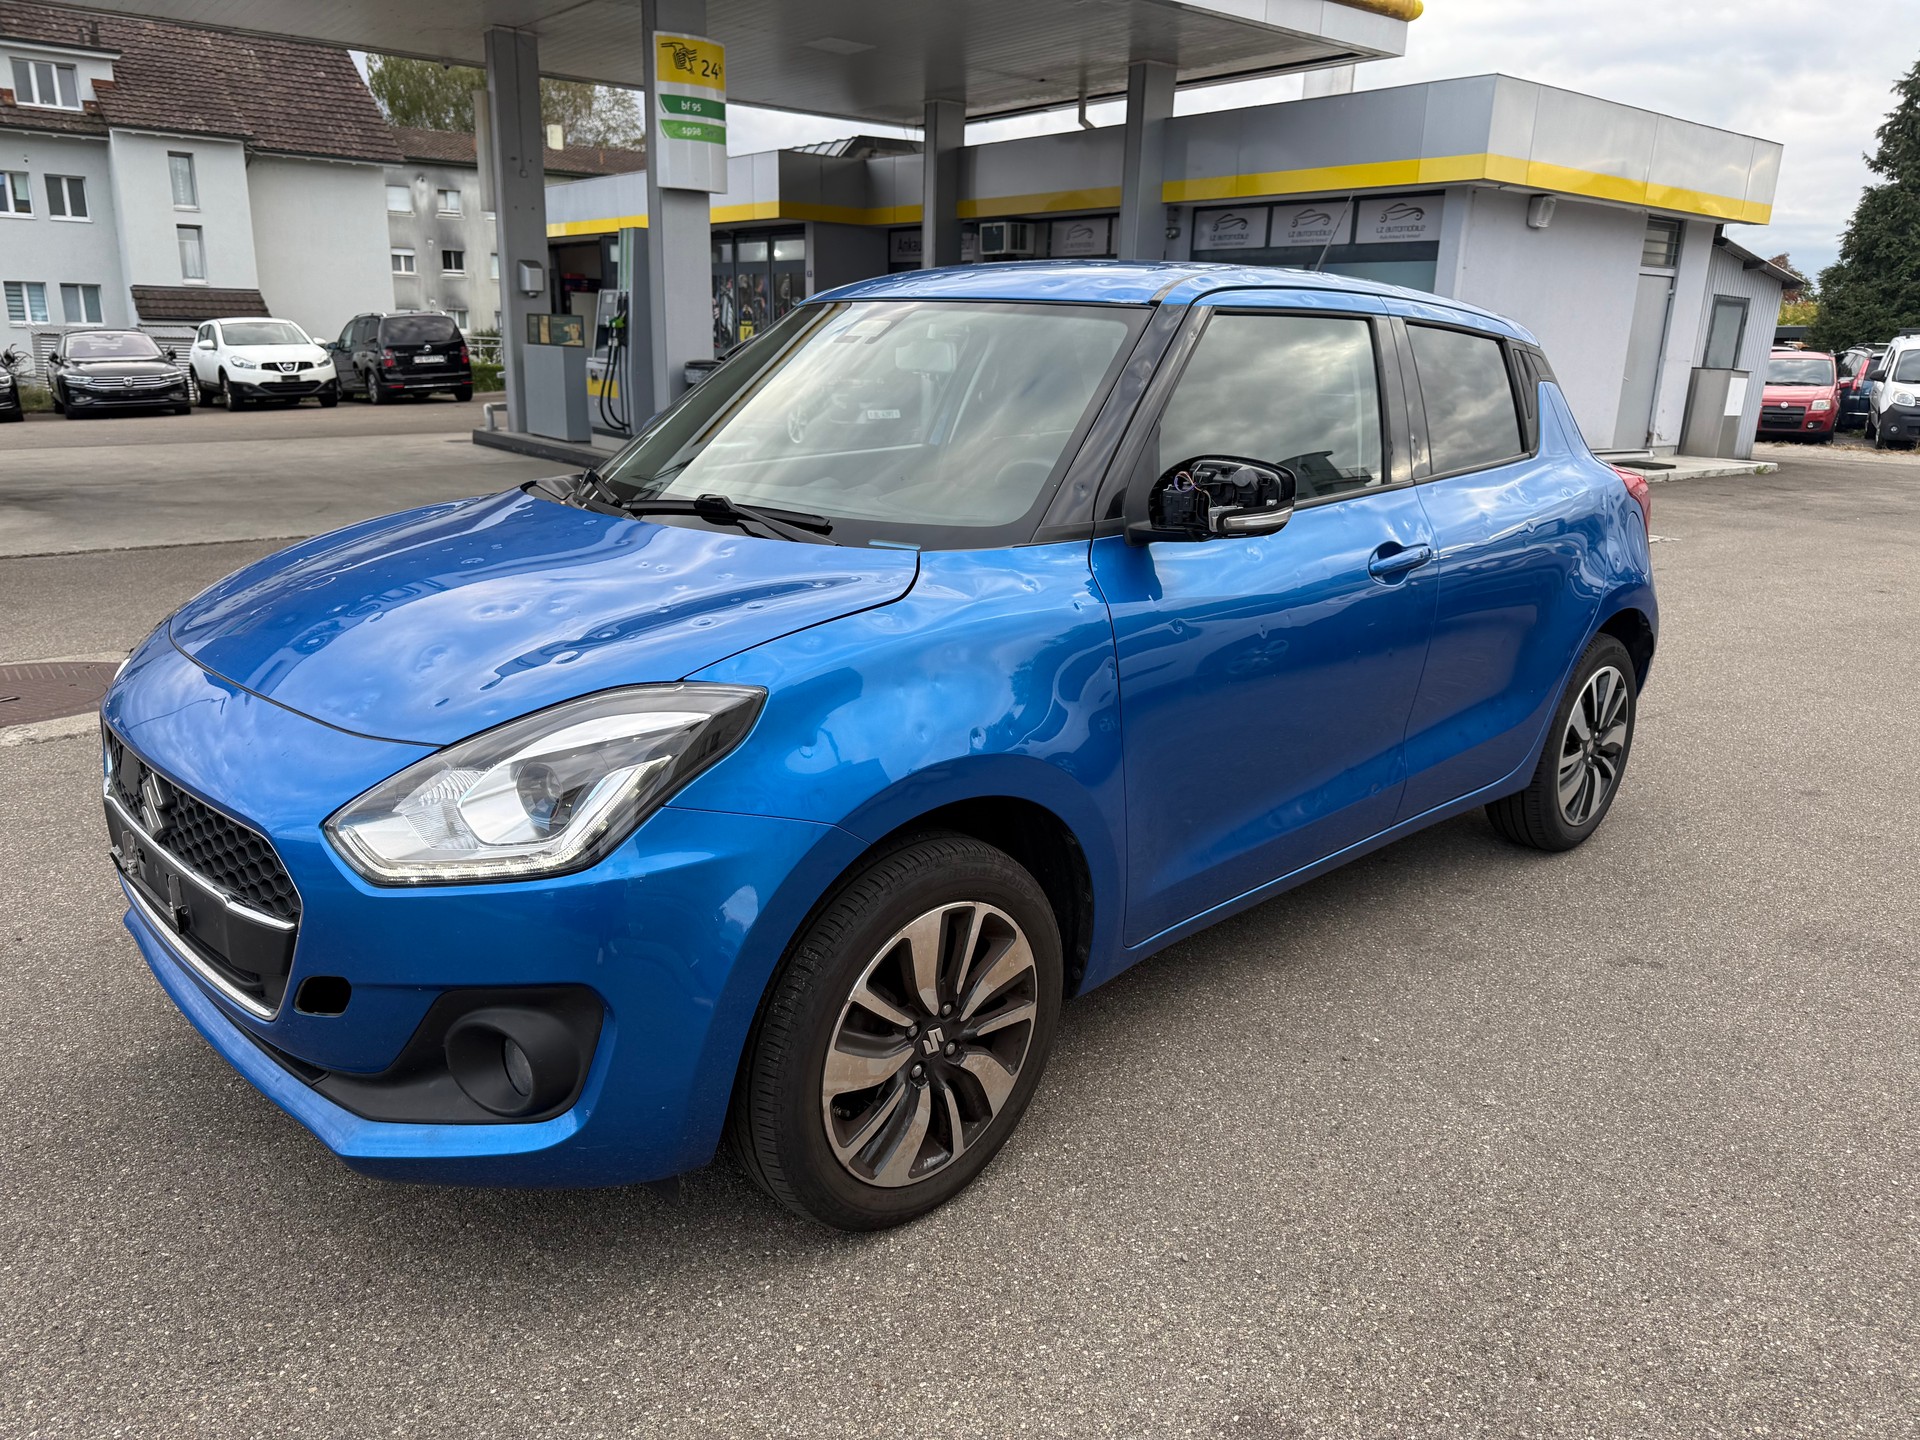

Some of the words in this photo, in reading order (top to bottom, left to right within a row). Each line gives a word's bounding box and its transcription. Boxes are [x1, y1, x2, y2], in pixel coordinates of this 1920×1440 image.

[680, 100, 691, 111] bf
[691, 103, 702, 112] 95
[681, 127, 702, 137] sp98
